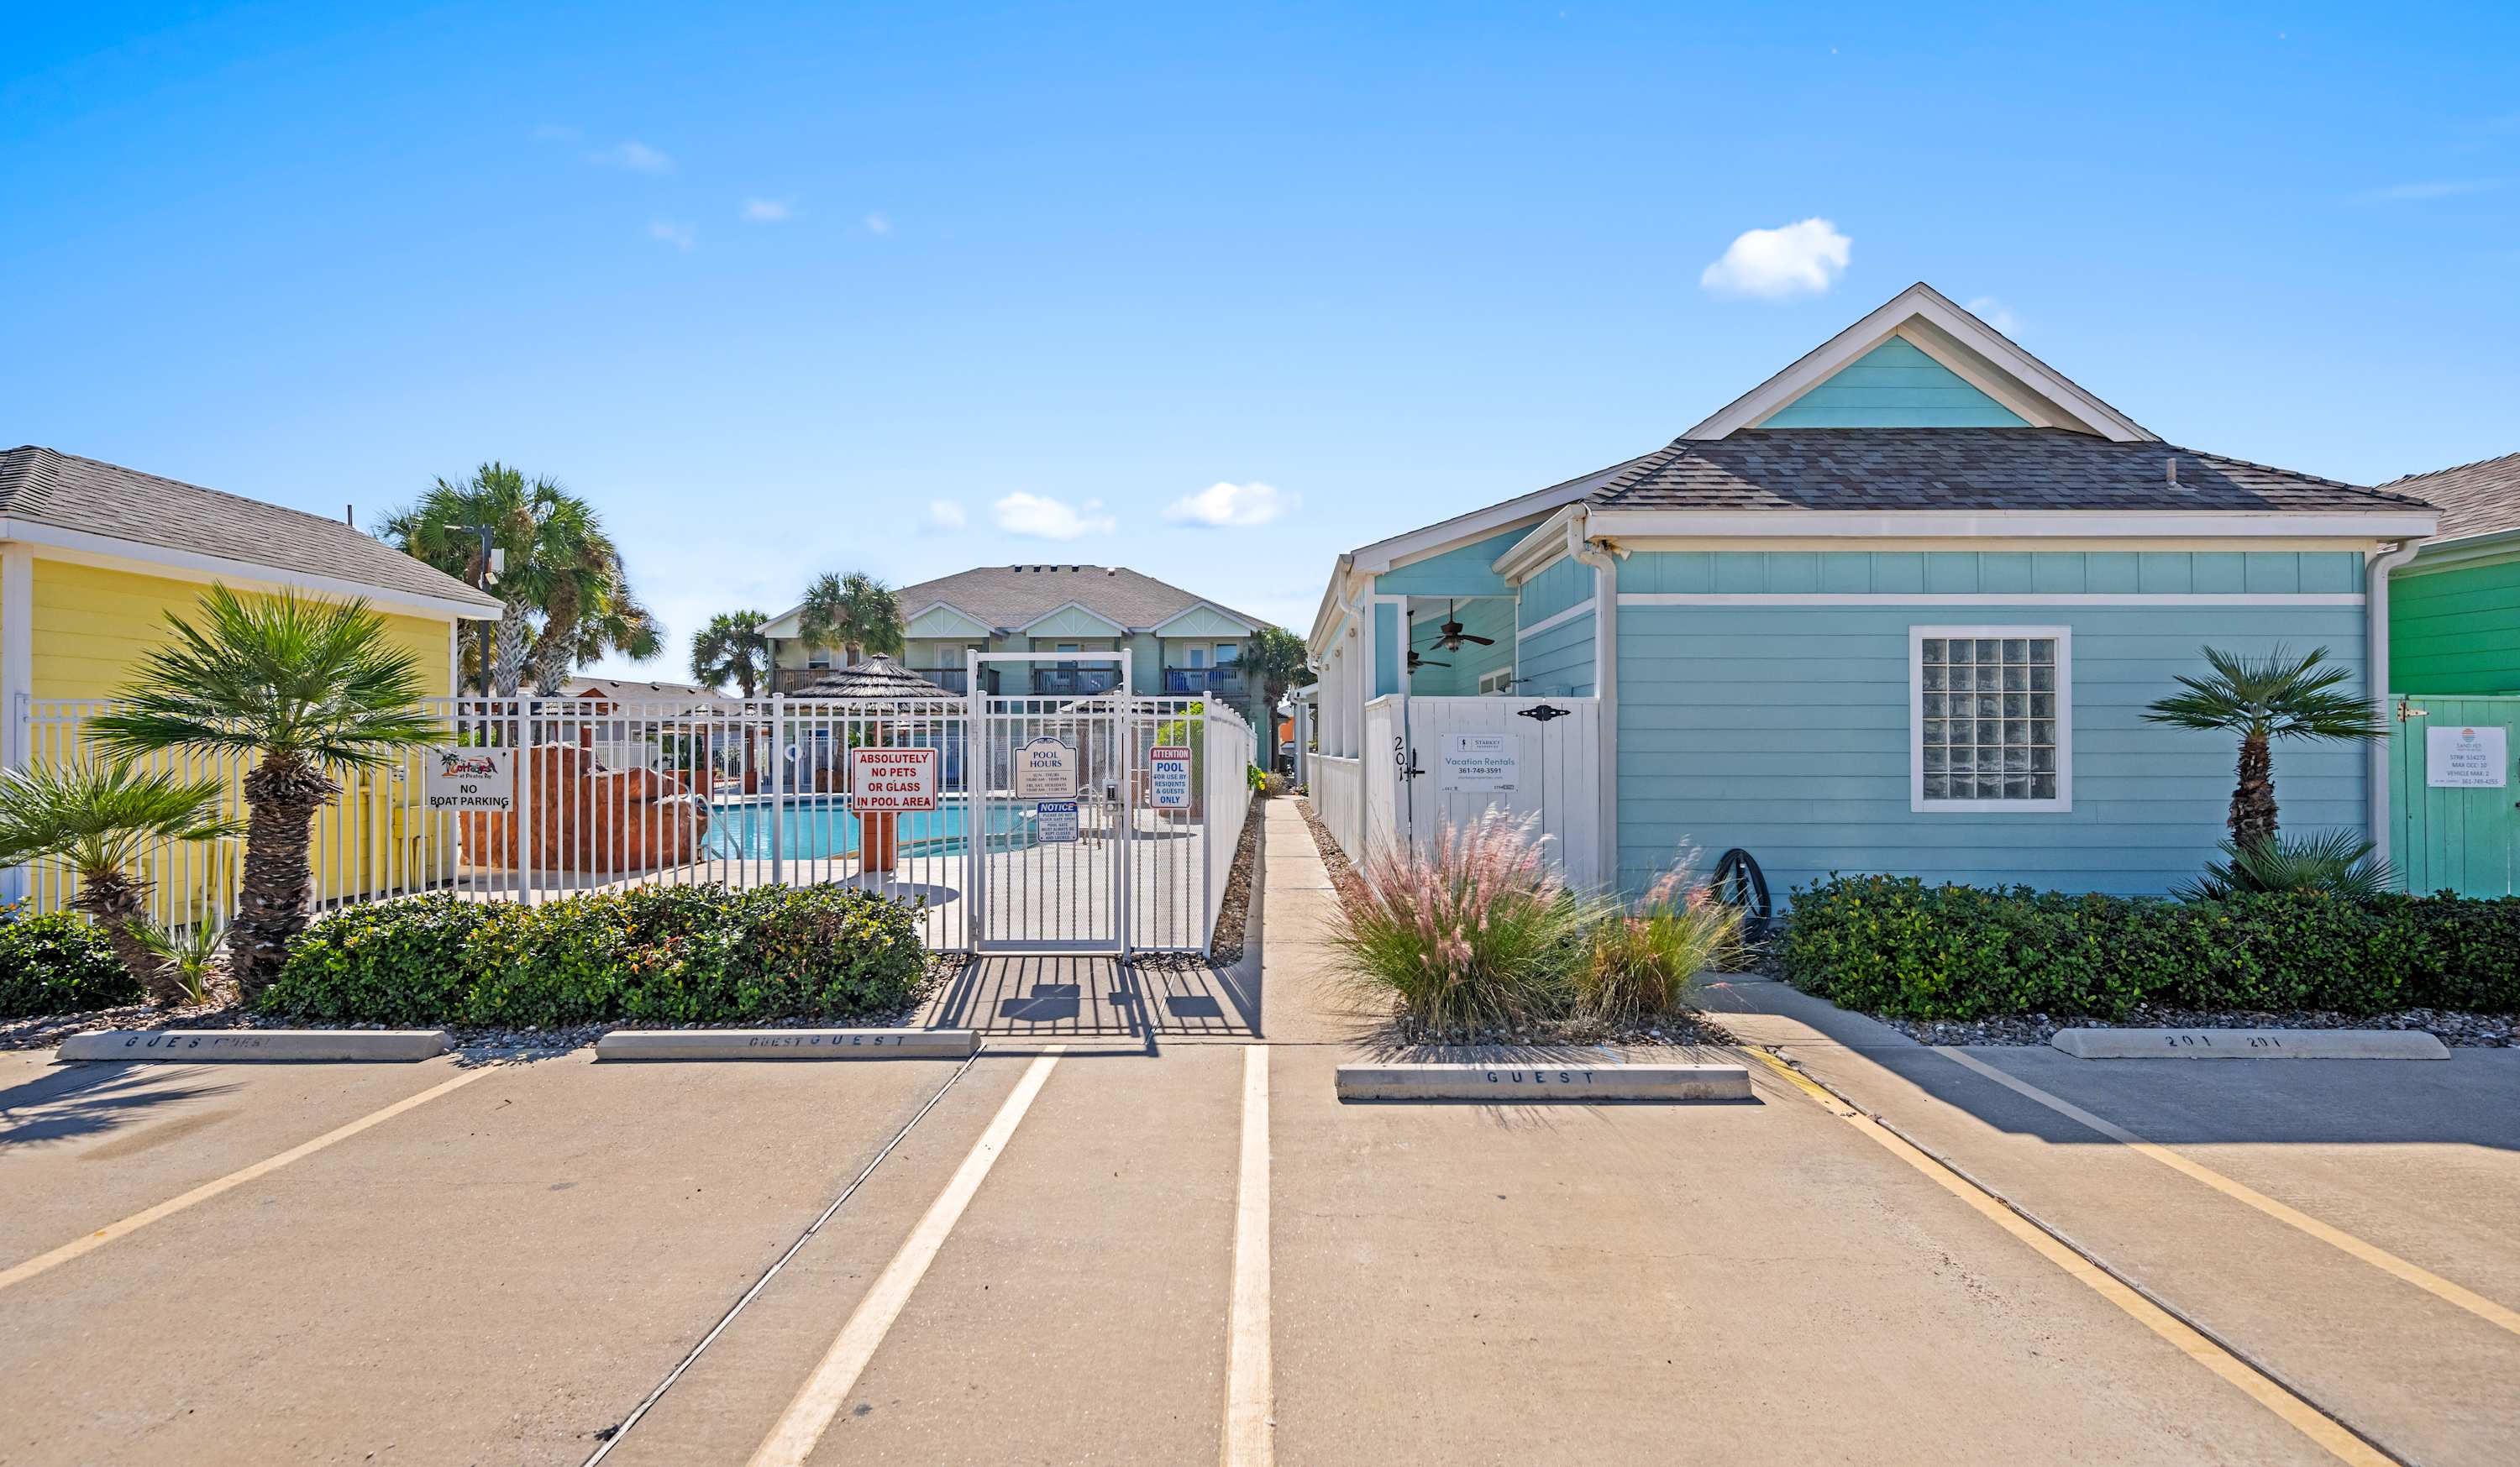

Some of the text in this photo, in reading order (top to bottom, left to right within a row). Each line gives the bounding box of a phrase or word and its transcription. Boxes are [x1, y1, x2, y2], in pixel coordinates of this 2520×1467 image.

[1152, 749, 1189, 758] ATTENTION
[860, 754, 929, 763] ABSOLUTELY
[1445, 757, 1515, 766] Vacation Rentals
[1030, 759, 1063, 768] HOURS
[1157, 762, 1184, 772] POOL
[871, 768, 916, 777] NO PETS
[460, 785, 477, 794] NO
[868, 783, 921, 792] OR GLASS
[430, 796, 509, 806] BOAT PARKING
[857, 797, 931, 806] IN POOL AREA
[1040, 803, 1074, 812] NOTICE
[810, 1035, 905, 1046] GUEST
[2165, 1035, 2281, 1047] 201 201
[1487, 1071, 1593, 1084] GUEST
